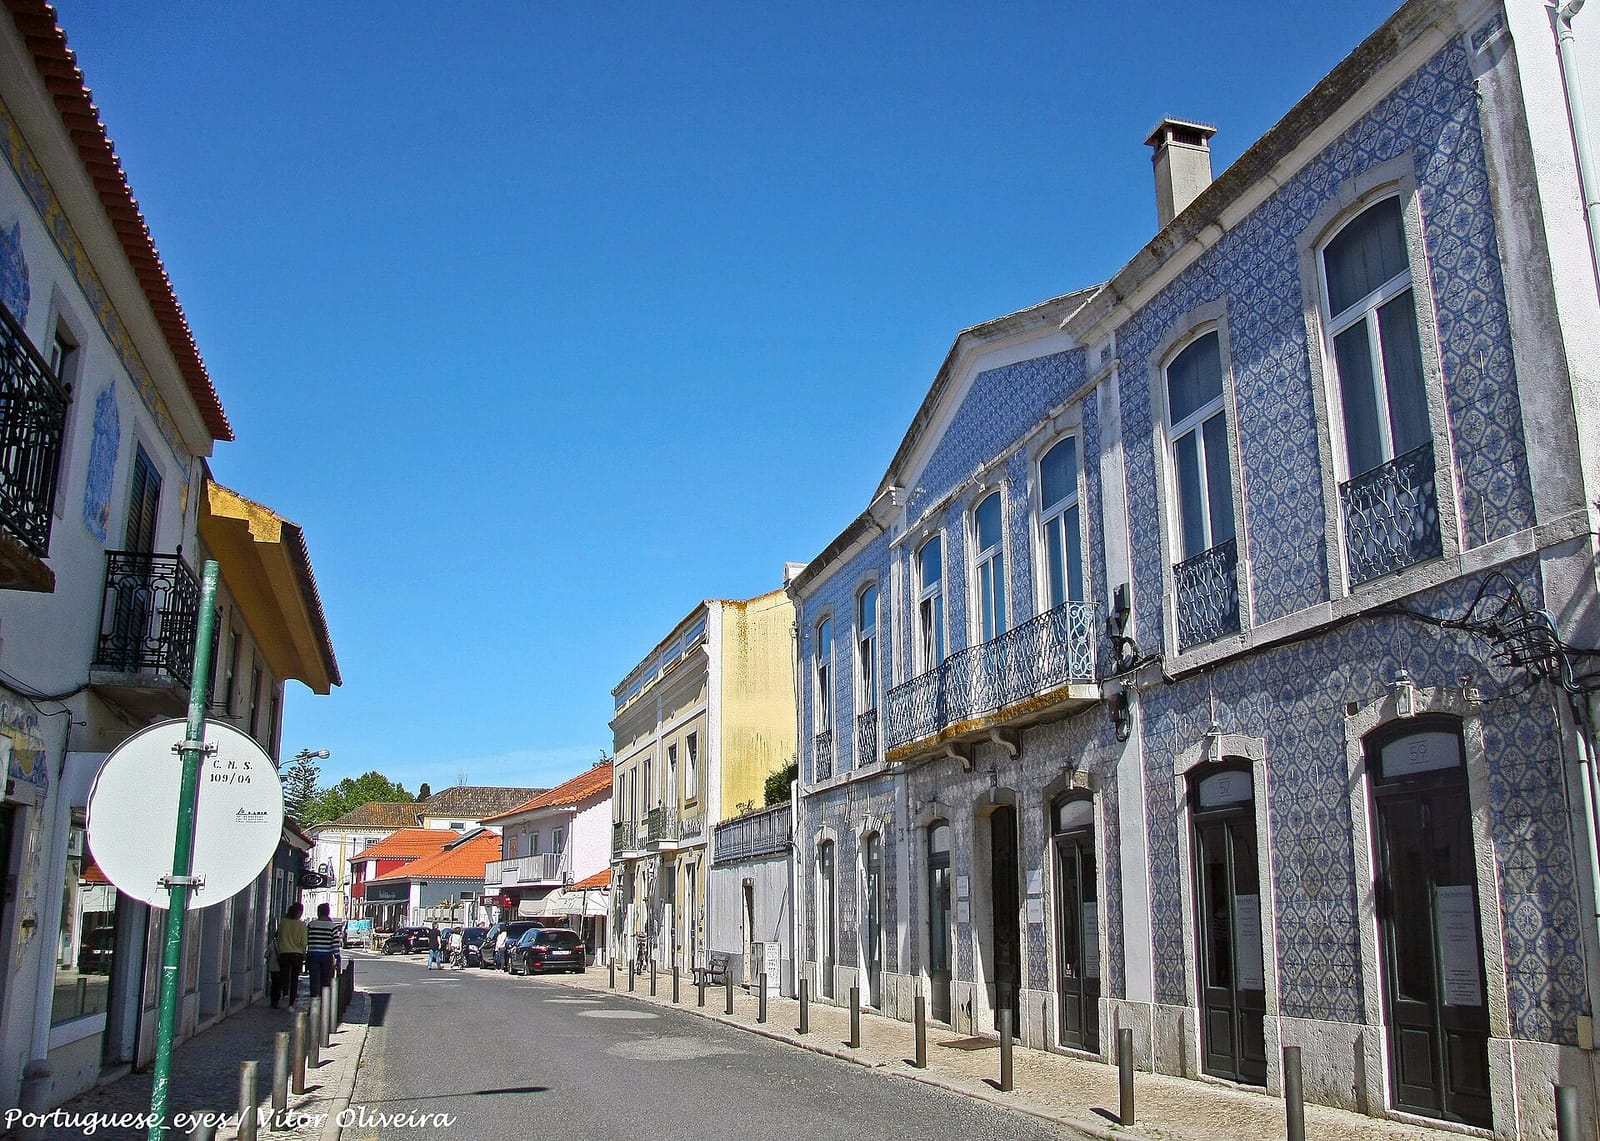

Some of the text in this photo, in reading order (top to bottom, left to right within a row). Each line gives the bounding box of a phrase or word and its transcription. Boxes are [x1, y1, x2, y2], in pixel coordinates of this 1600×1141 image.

[1410, 744, 1426, 761] 59
[243, 761, 253, 770] S.
[210, 772, 251, 785] 109/04
